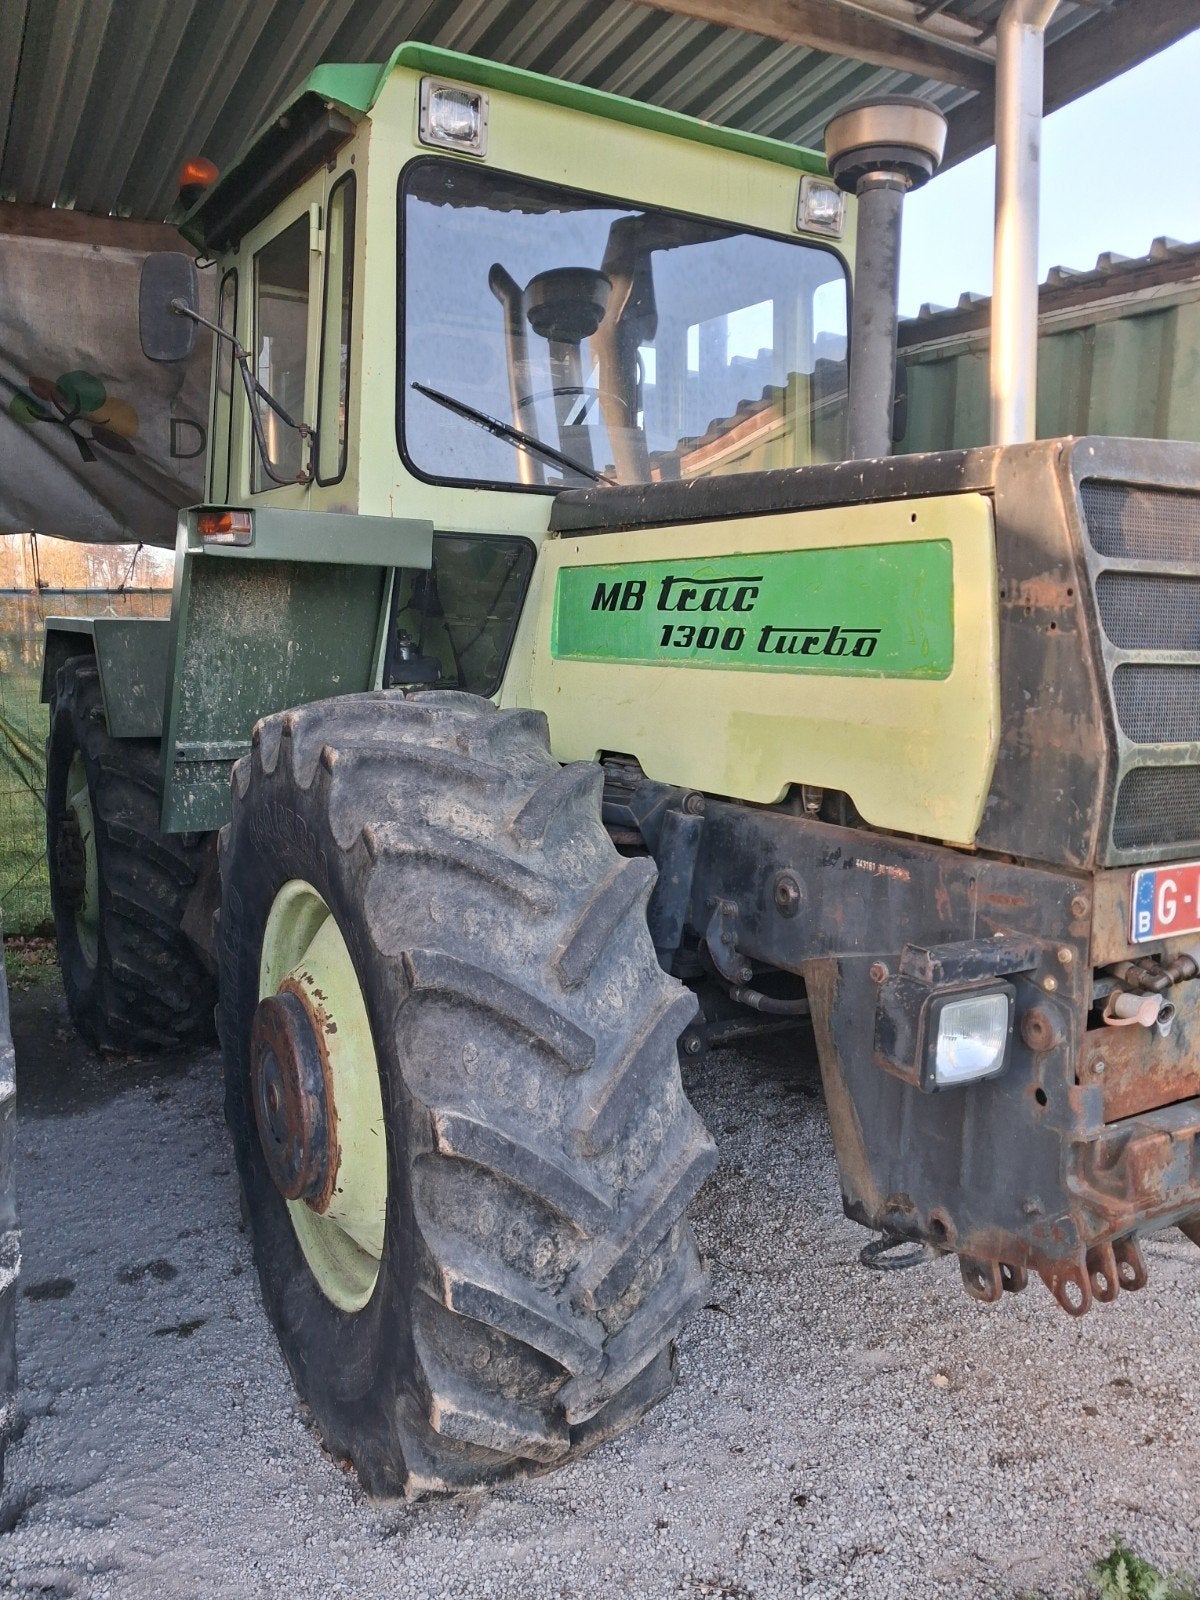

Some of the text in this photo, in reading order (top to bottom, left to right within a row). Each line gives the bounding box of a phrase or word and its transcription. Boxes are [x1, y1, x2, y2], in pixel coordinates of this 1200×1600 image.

[170, 418, 207, 459] D
[591, 575, 764, 612] MB trac
[660, 624, 882, 658] 1300 turbo
[1158, 873, 1200, 925] G-
[1138, 911, 1151, 933] B
